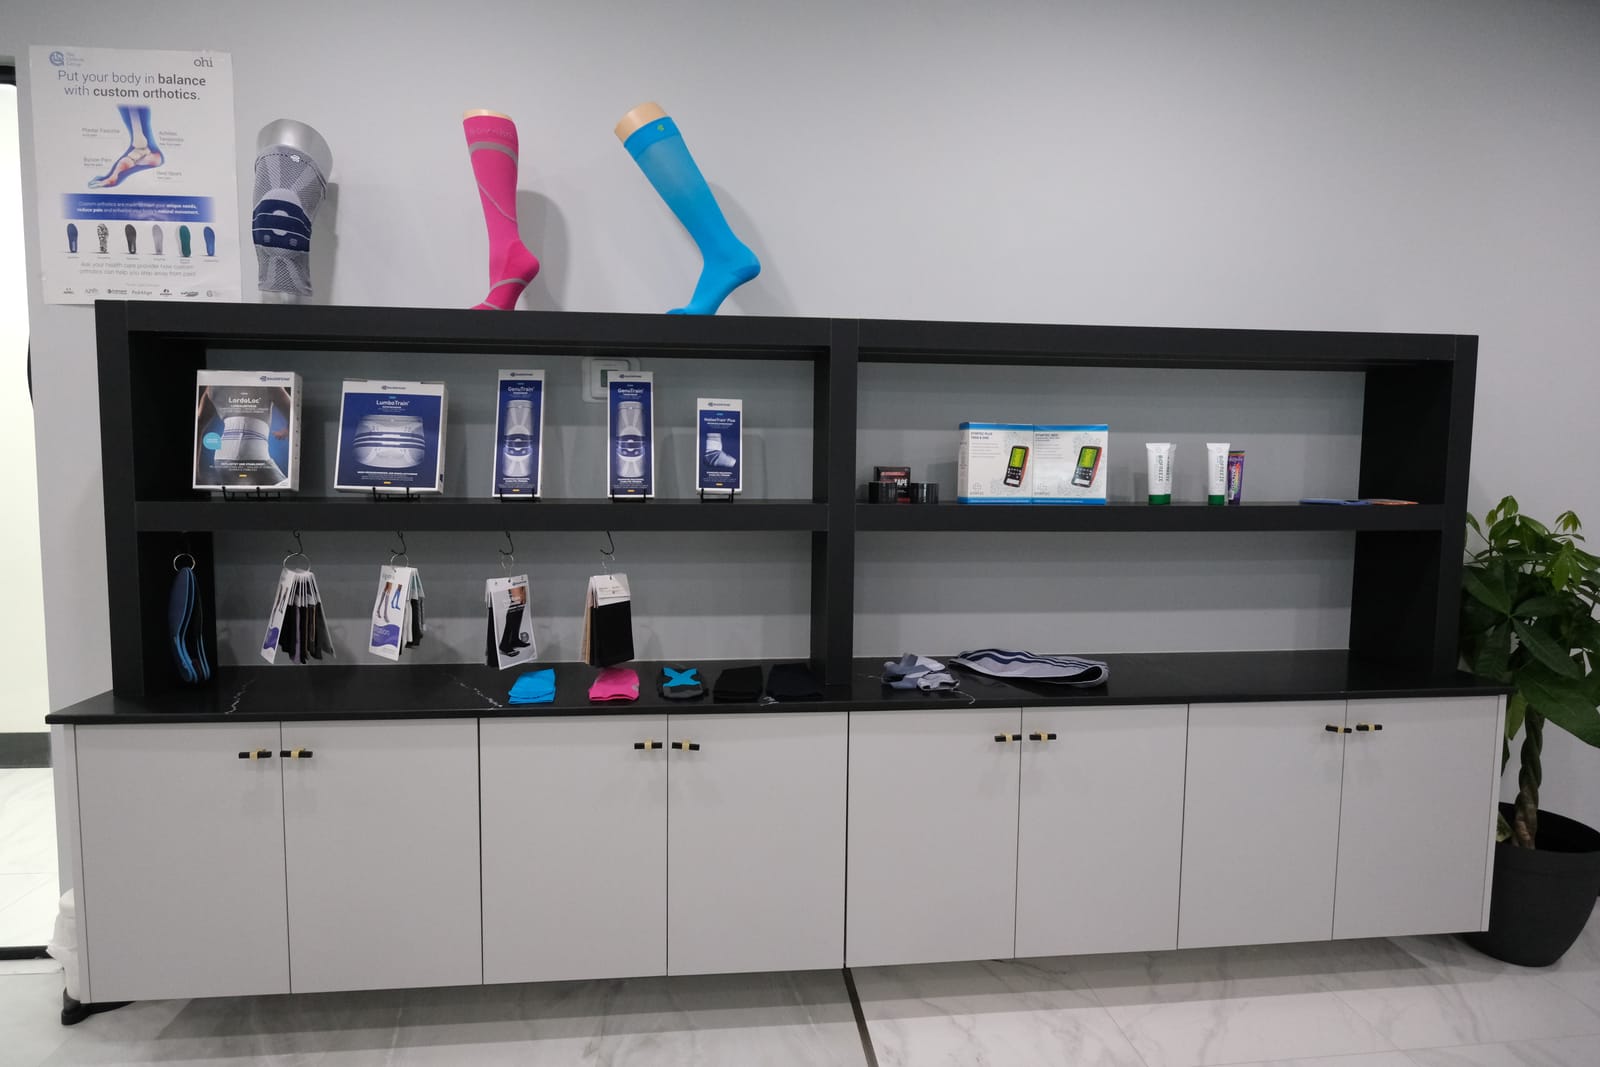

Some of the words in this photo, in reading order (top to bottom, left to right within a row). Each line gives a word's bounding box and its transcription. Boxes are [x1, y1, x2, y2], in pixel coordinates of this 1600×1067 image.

[194, 57, 213, 68] ohi
[58, 70, 78, 81] Put
[82, 72, 108, 84] your
[112, 72, 141, 86] body
[144, 73, 154, 84] in
[158, 73, 206, 86] balance
[64, 84, 90, 96] with
[93, 88, 139, 98] custom
[143, 88, 200, 100] orthotics.
